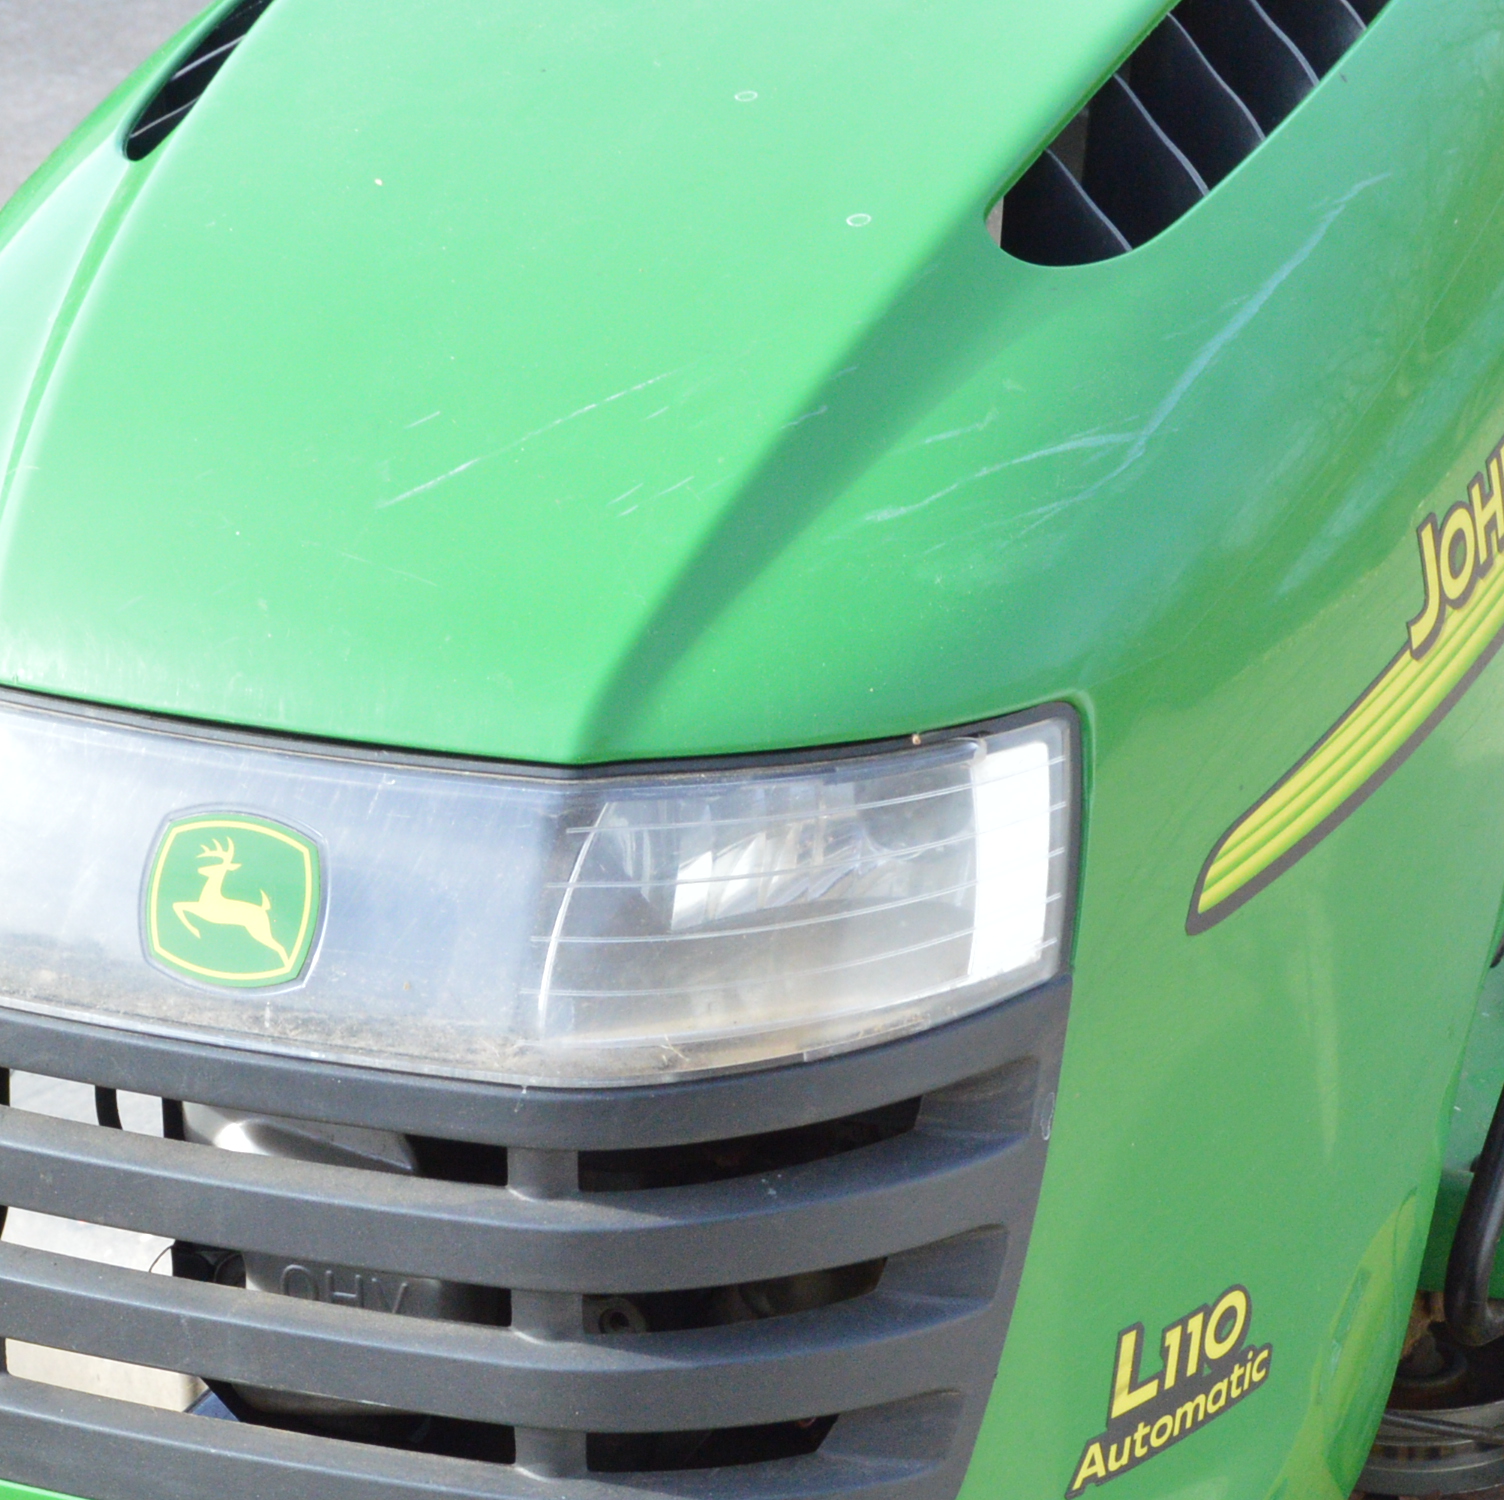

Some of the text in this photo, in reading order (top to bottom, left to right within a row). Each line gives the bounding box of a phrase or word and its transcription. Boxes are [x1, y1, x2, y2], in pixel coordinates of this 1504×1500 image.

[279, 1263, 410, 1315] OHV
[1109, 1288, 1248, 1419] L110
[1070, 1347, 1270, 1492] Automatic
